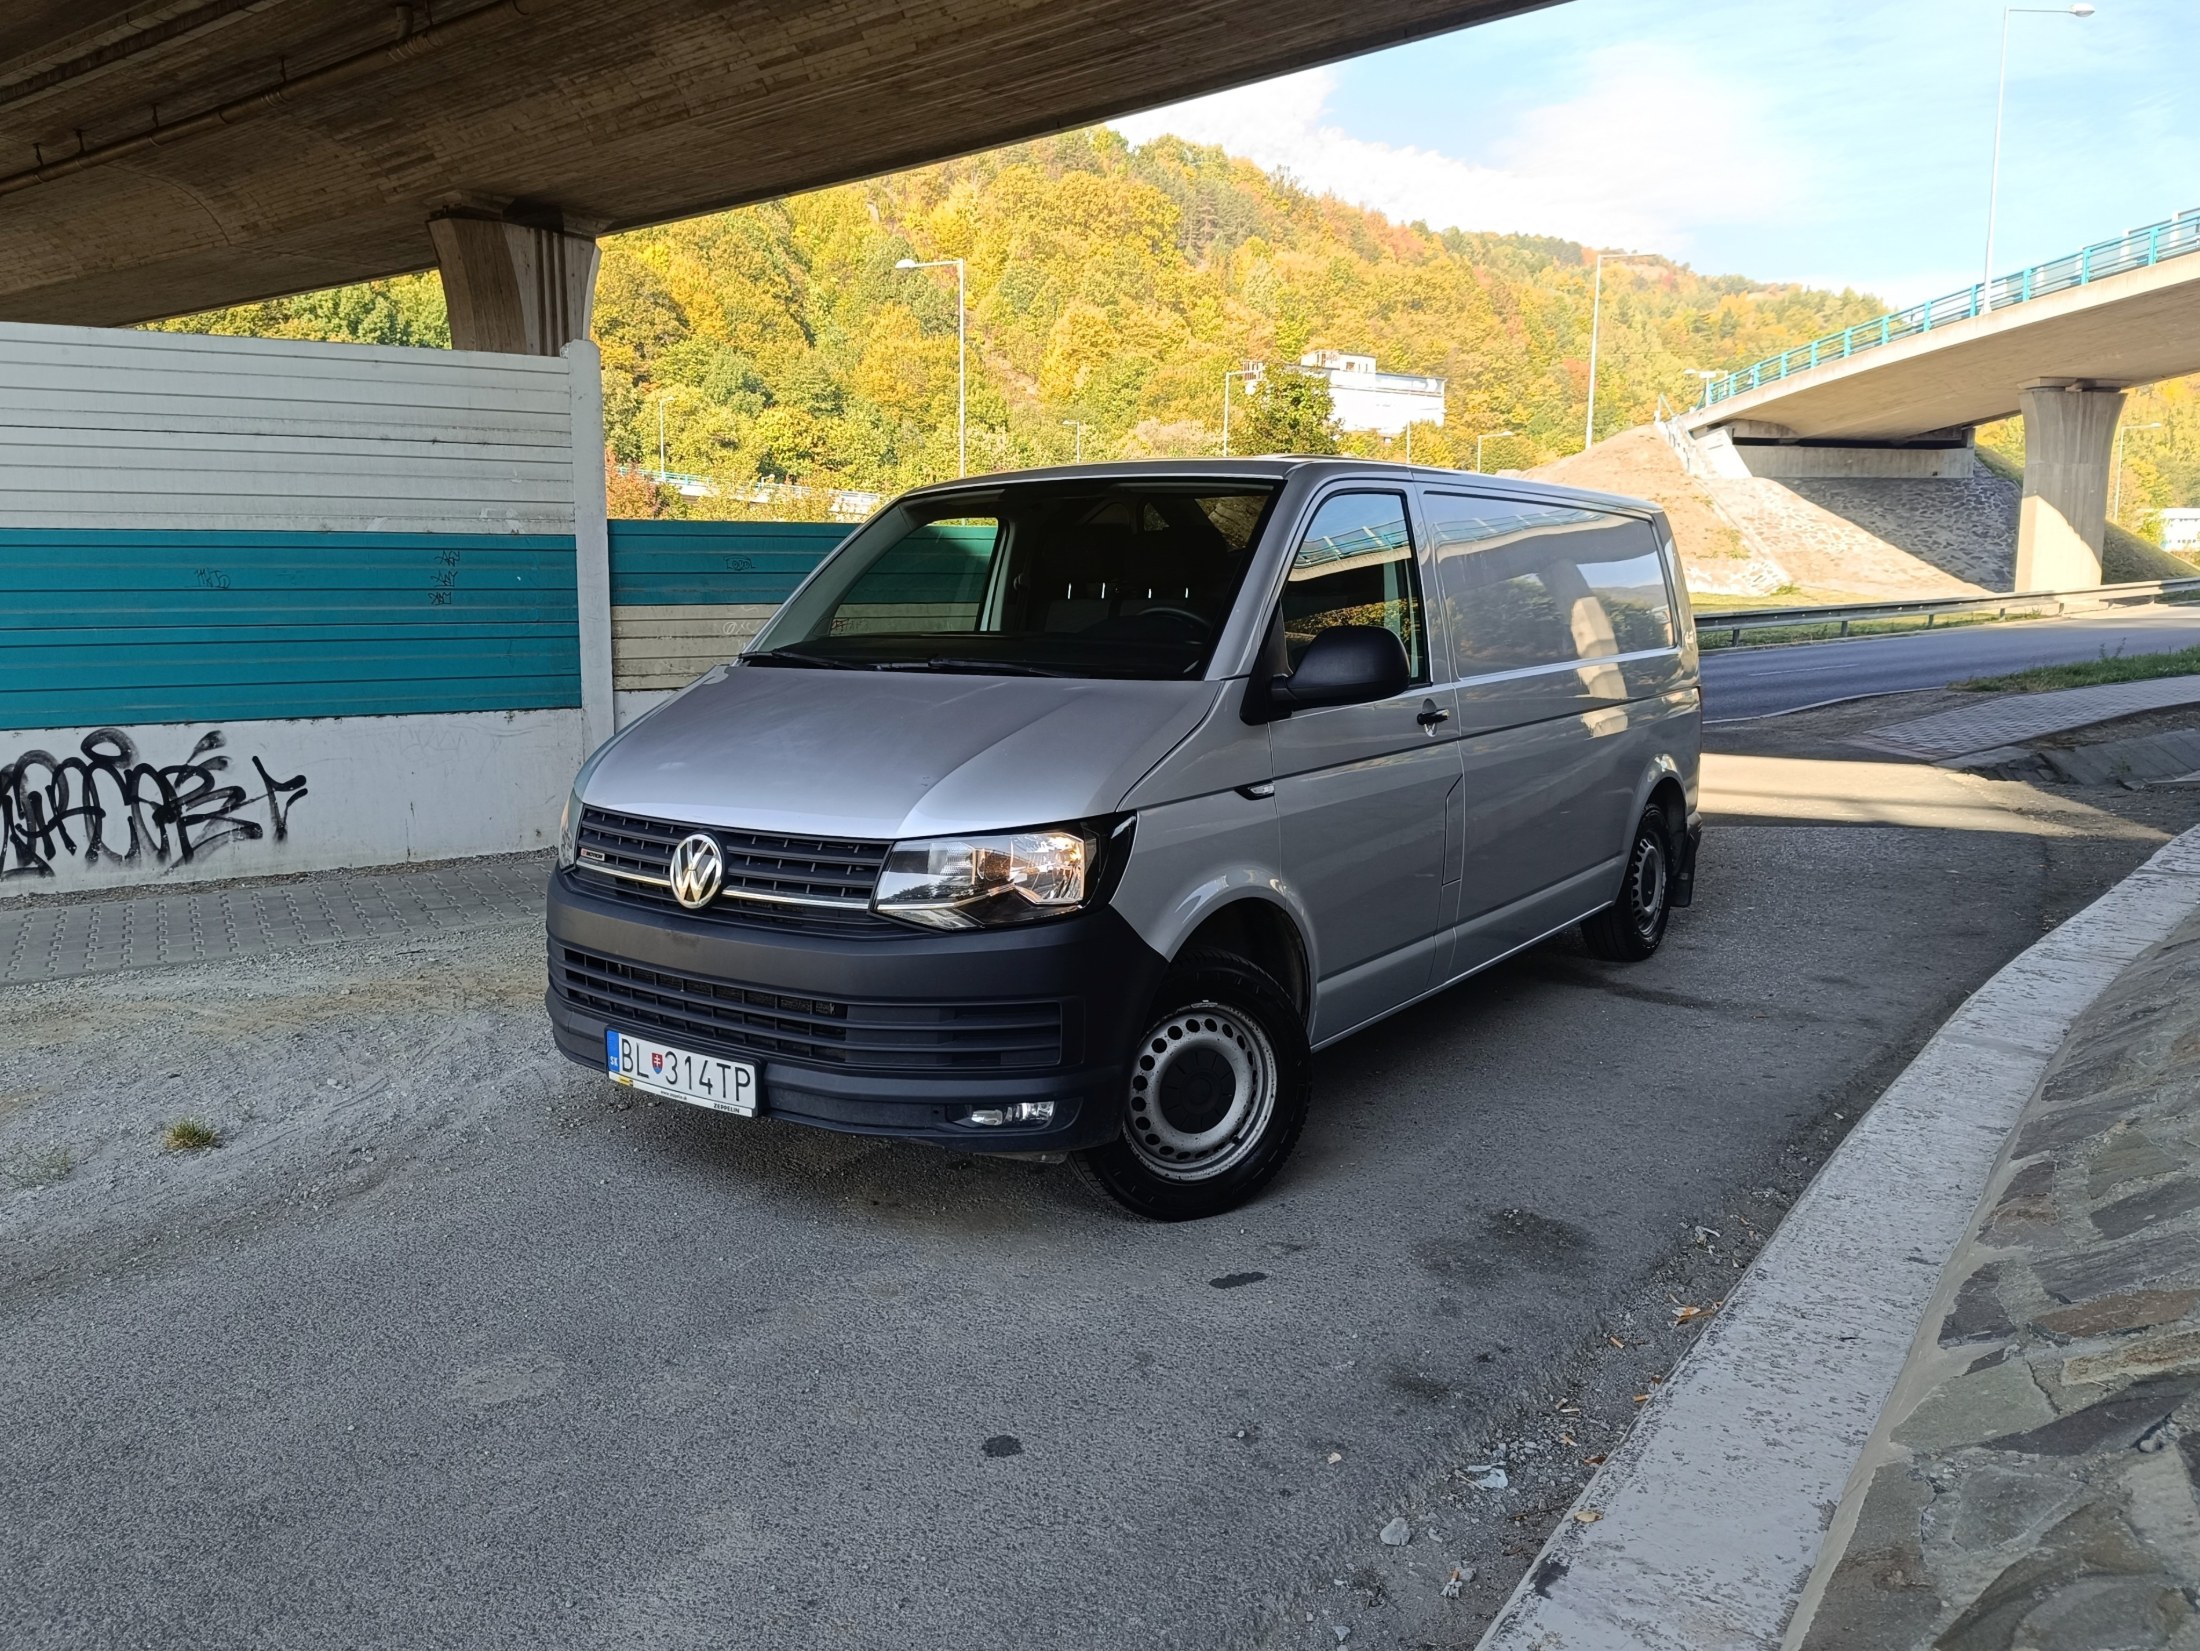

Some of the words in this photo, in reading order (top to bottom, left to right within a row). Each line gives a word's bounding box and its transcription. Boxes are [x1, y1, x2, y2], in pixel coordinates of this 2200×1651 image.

[610, 1055, 619, 1067] SK
[621, 1038, 650, 1079] BL
[665, 1050, 751, 1102] 314TP
[713, 1102, 740, 1114] ZEPPELIN
